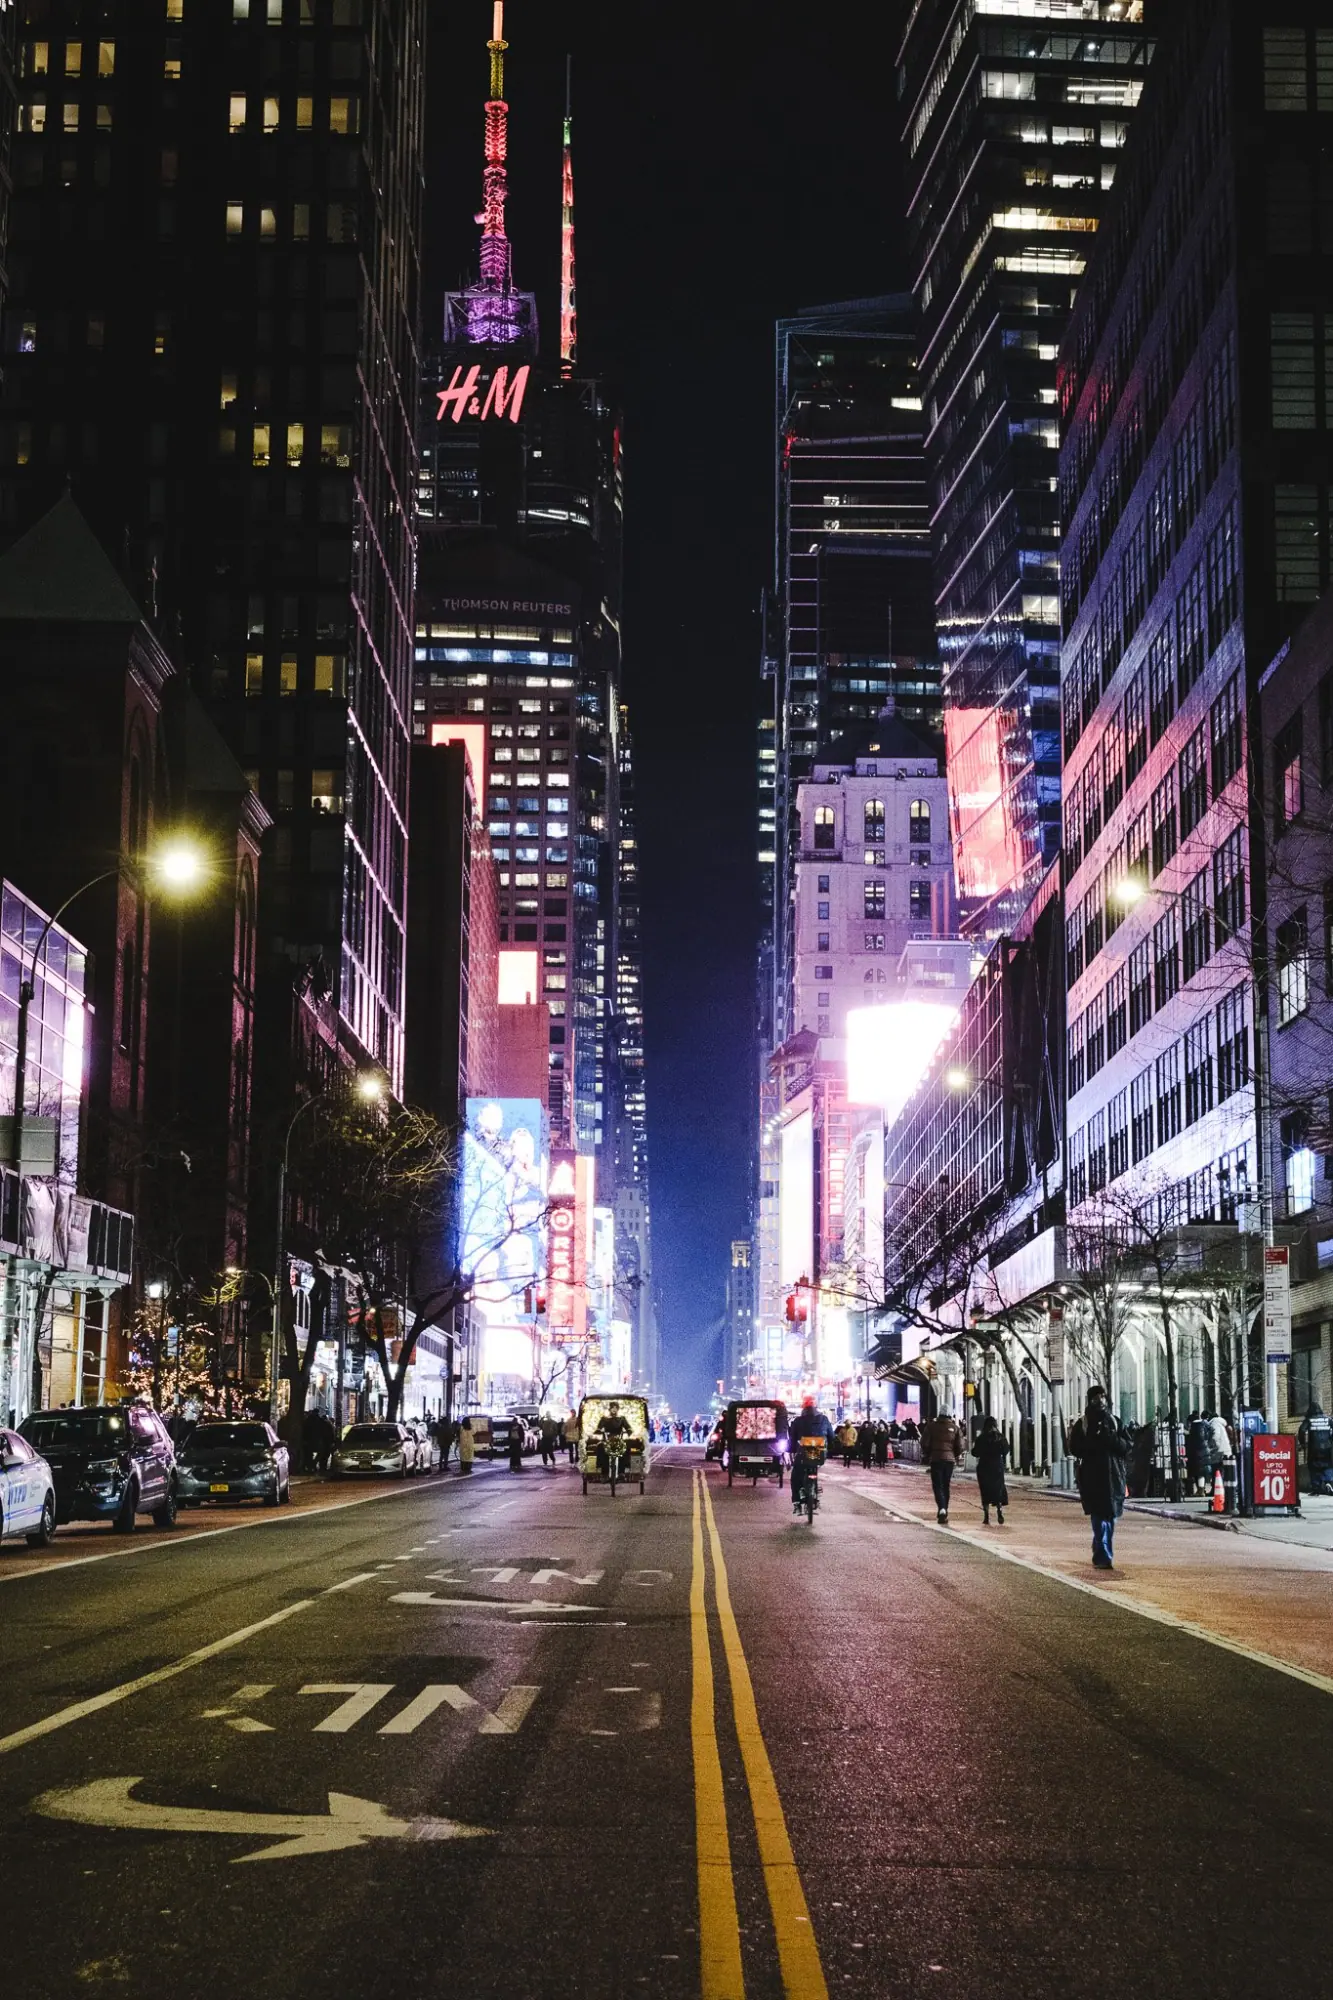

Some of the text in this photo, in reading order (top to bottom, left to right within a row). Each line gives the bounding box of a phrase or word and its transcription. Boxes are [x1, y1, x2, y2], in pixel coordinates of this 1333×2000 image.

[436, 365, 530, 424] H&M
[443, 598, 572, 614] THOMSON REUTERS
[551, 1236, 571, 1311] REGAL
[1258, 1450, 1291, 1461] Special
[1260, 1476, 1284, 1500] 10
